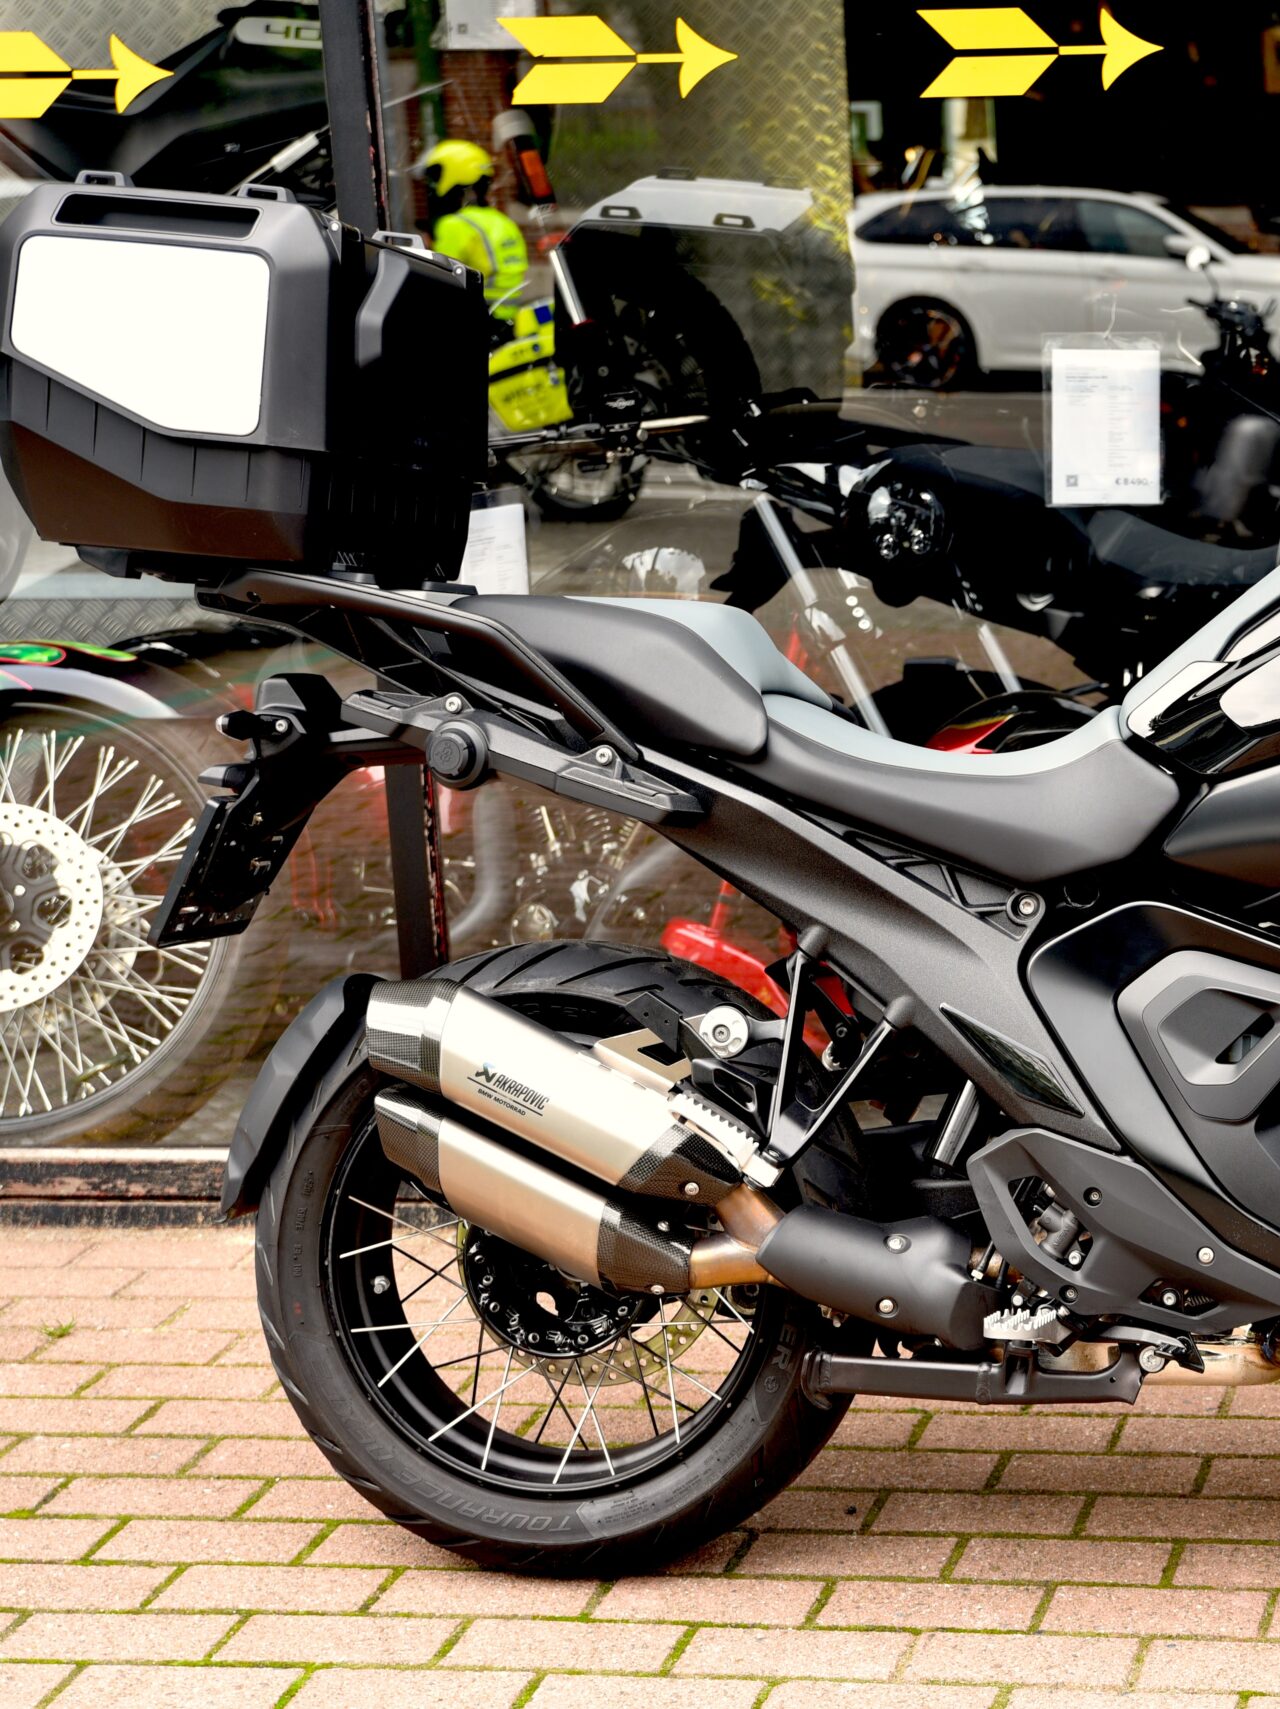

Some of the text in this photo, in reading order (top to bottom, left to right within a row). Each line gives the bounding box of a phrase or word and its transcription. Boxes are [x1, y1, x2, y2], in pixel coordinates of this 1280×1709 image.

[478, 1088, 526, 1116] BMW MOTORRAD
[391, 1465, 572, 1532] TOURANCE
